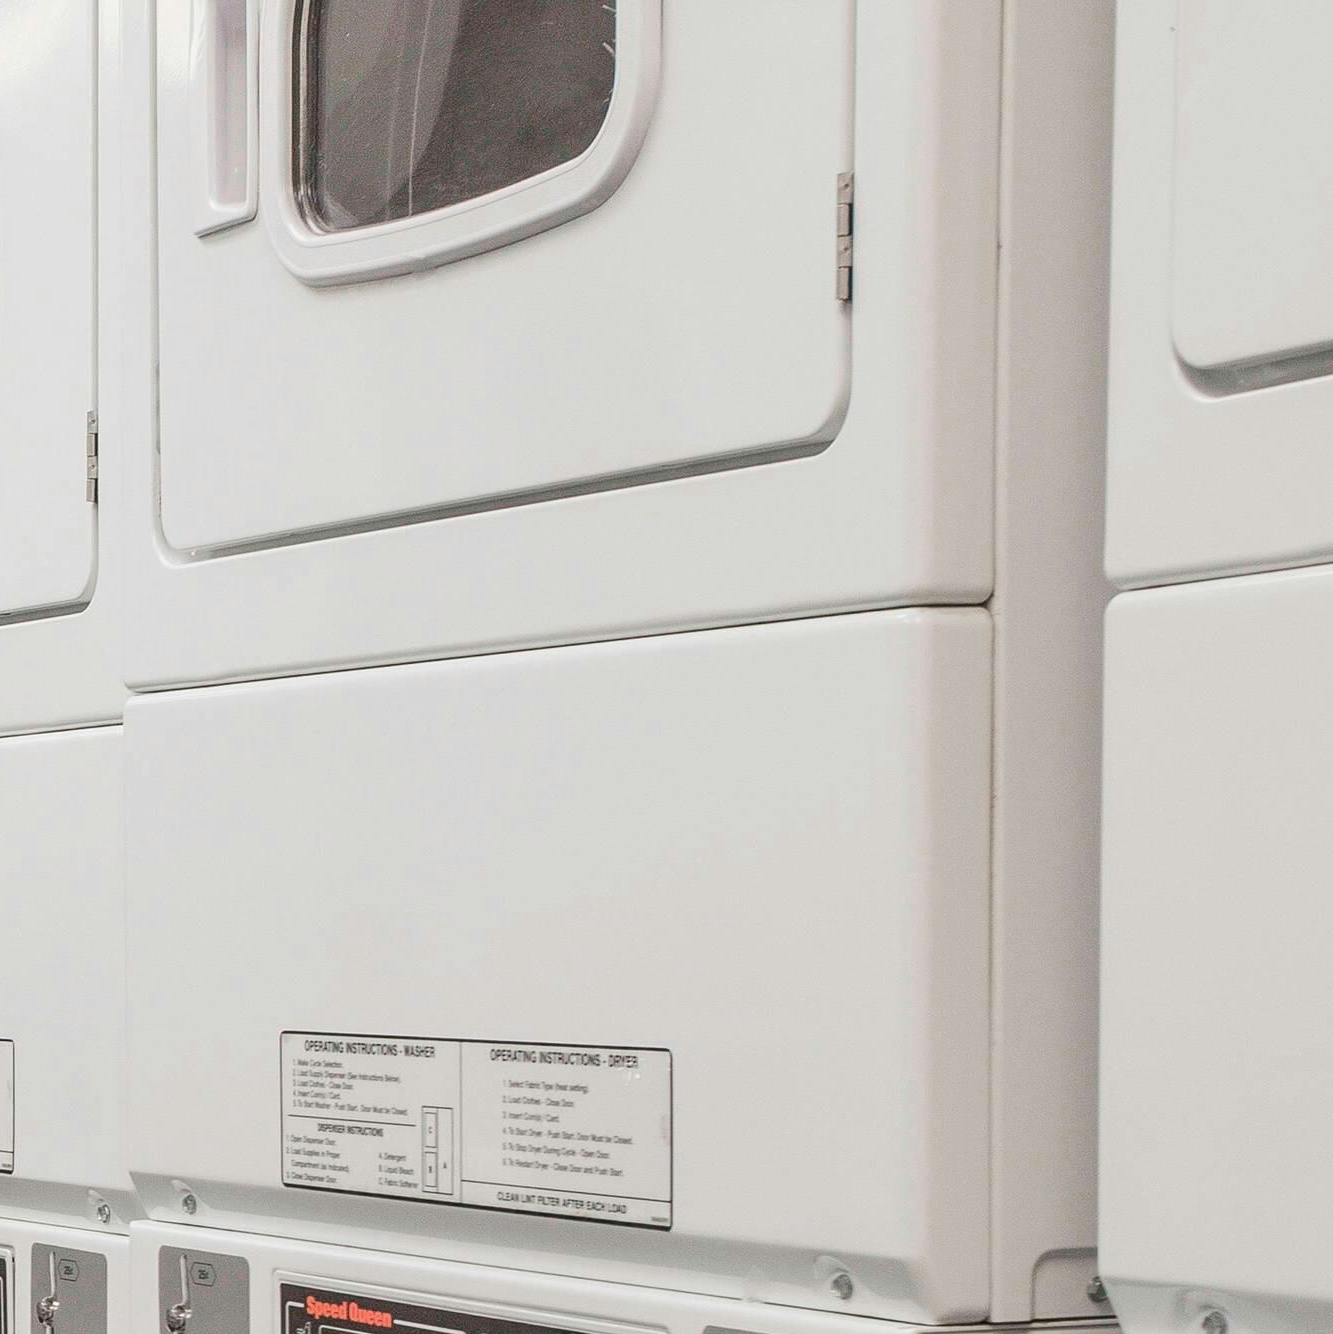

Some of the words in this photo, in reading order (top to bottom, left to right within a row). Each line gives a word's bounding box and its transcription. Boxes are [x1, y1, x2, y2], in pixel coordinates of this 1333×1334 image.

[304, 1040, 344, 1053] OPERATING
[345, 1042, 398, 1056] INSTRUCTIONS
[404, 1045, 436, 1058] WASHER
[490, 1049, 536, 1063] OPERATING
[539, 1051, 601, 1067] INSTRUCTIONS
[608, 1054, 638, 1068] DRYER
[347, 1125, 383, 1137] INSTRUCTIONS
[497, 1191, 519, 1202] CLEAN
[521, 1193, 535, 1204] LINT
[537, 1195, 560, 1206] FILTER
[562, 1198, 584, 1210] AFTER
[586, 1200, 605, 1212] EACH
[607, 1203, 627, 1214] LOAD
[306, 1295, 348, 1320] Speed
[349, 1302, 393, 1328] Queen
